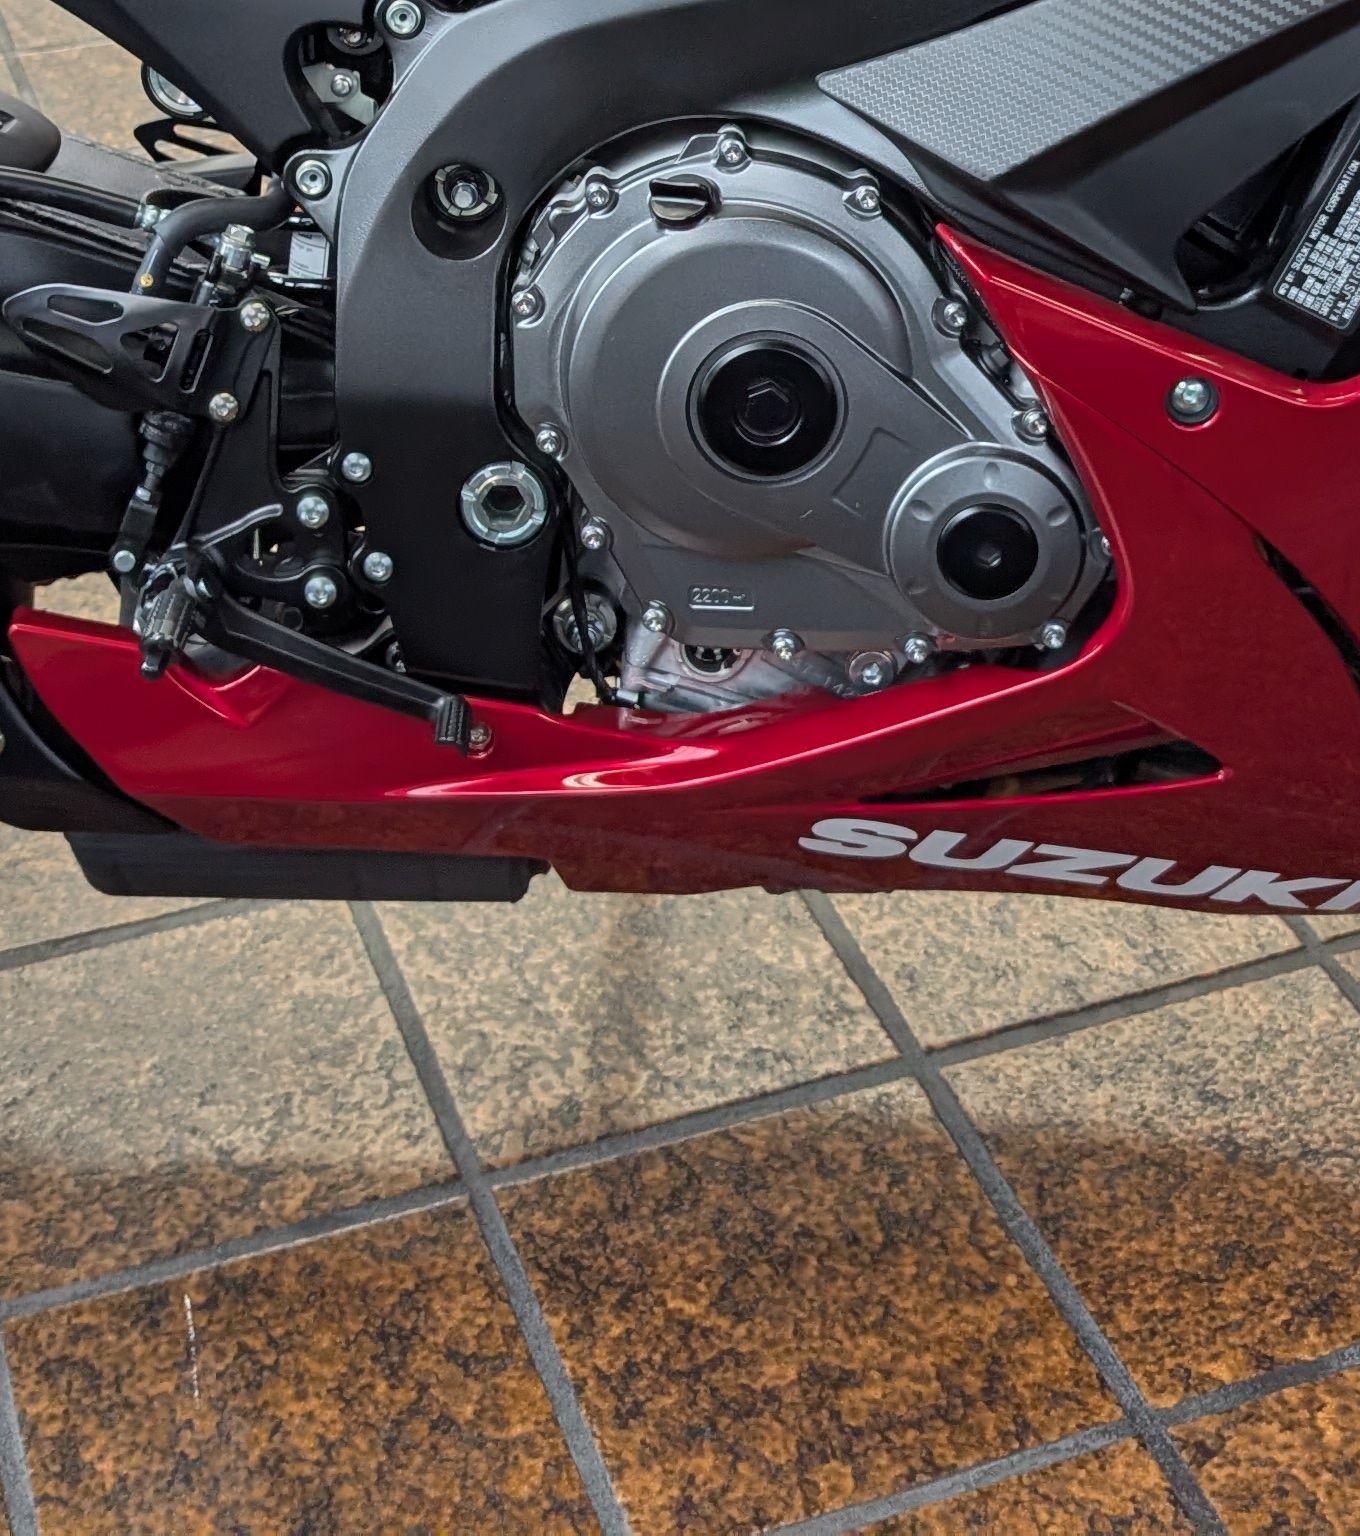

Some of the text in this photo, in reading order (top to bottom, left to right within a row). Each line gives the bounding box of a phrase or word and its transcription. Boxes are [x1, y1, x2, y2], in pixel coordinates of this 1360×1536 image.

[1289, 239, 1314, 272] SUZUKI
[1308, 212, 1329, 241] MOTOR
[1324, 158, 1360, 214] CORPORATION
